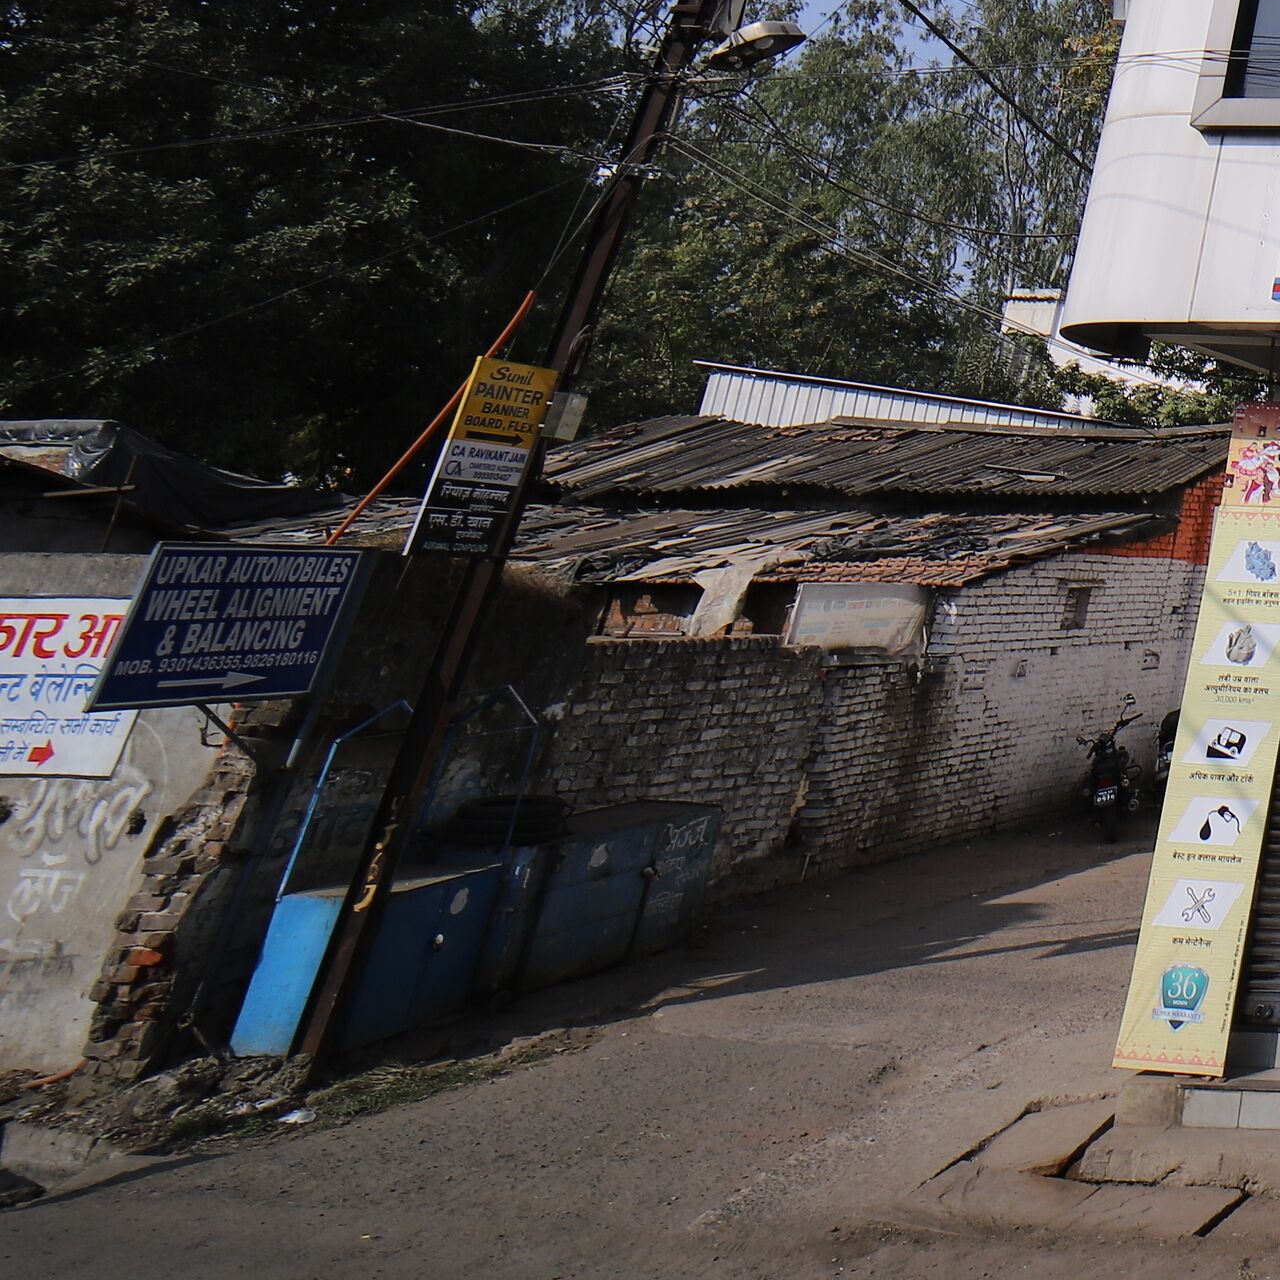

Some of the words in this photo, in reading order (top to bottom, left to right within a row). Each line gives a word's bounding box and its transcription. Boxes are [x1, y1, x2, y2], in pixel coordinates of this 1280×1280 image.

[490, 367, 535, 386] Sunil
[474, 382, 544, 406] PAINTER
[481, 402, 529, 419] BANNER
[507, 420, 534, 434] FLEX
[451, 445, 465, 457] CA
[468, 448, 510, 462] RAVIKANT
[156, 556, 228, 585] UPKAR
[225, 556, 352, 583] AUTOMOBILES
[145, 588, 221, 621] WHEEL
[222, 587, 341, 619] ALIGNMENT
[156, 625, 177, 657] &
[180, 621, 306, 655] BALANCING
[1167, 971, 1197, 999] 36
